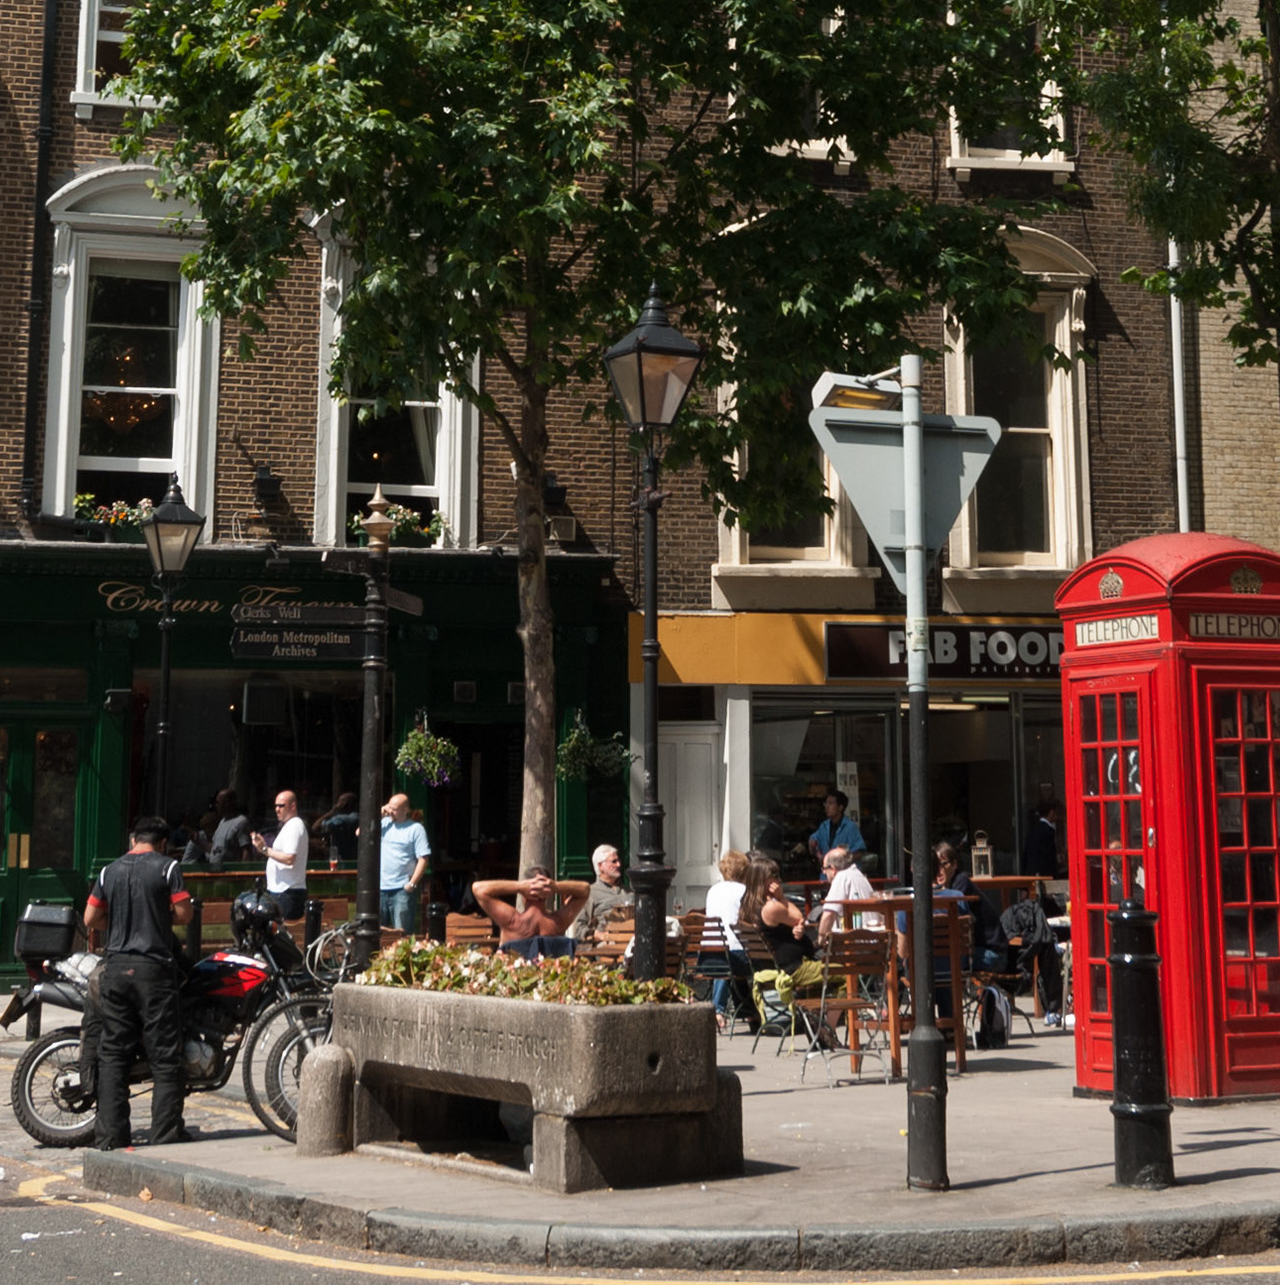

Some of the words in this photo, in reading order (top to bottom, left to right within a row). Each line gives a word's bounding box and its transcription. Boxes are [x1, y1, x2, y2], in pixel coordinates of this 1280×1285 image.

[97, 580, 225, 613] Crown
[239, 607, 271, 619] Clerks
[278, 607, 302, 620] Well
[239, 630, 279, 643] London
[282, 631, 351, 646] Metropolitan
[1080, 616, 1158, 644] TELEPHONE
[271, 645, 318, 657] Archives
